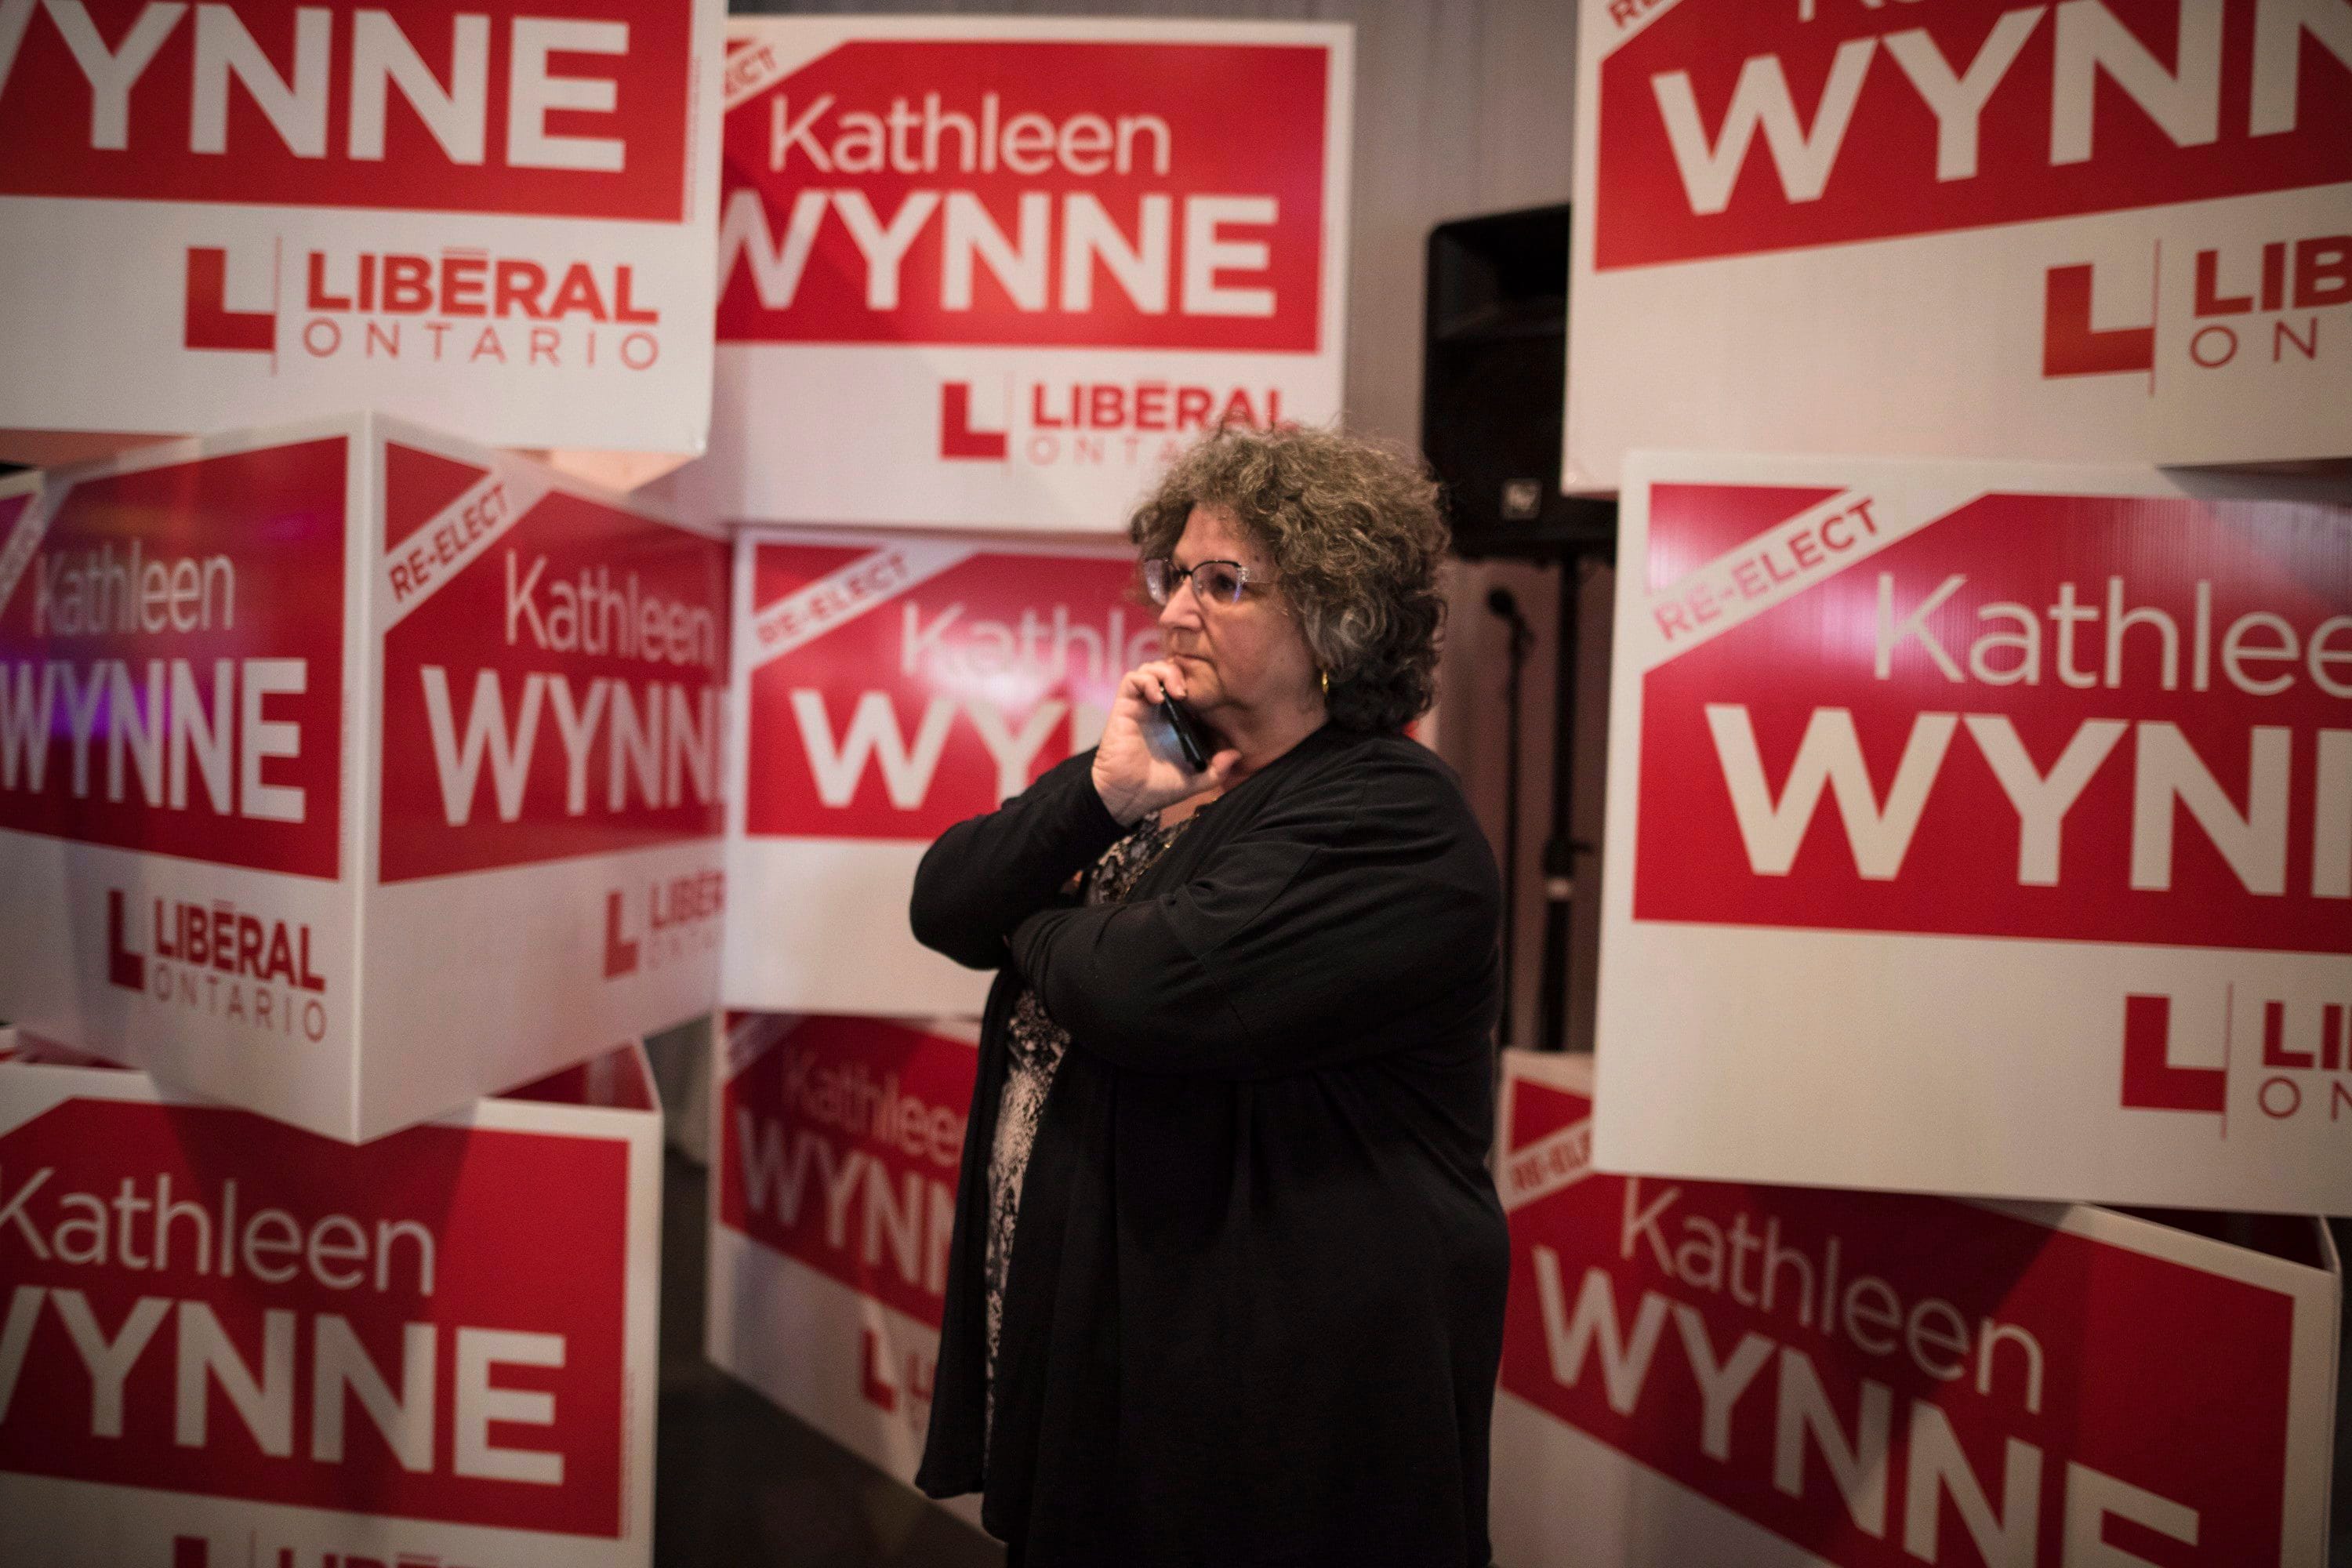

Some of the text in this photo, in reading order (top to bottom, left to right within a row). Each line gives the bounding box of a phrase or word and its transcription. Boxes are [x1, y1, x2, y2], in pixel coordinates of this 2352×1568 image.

[0, 0, 630, 172] YNNE
[769, 92, 1171, 176] Kathleen
[718, 188, 1279, 316] WYNNE
[303, 317, 660, 371] ONTARIO
[390, 482, 508, 603] RE-ELECT
[1653, 497, 1879, 641] RE-ELECT
[506, 549, 716, 667] Kathleen
[1705, 702, 2352, 899] WYN
[156, 962, 328, 1043] ONTARIO
[1621, 1176, 2044, 1413] Kathleen
[0, 1284, 566, 1486] YNNE
